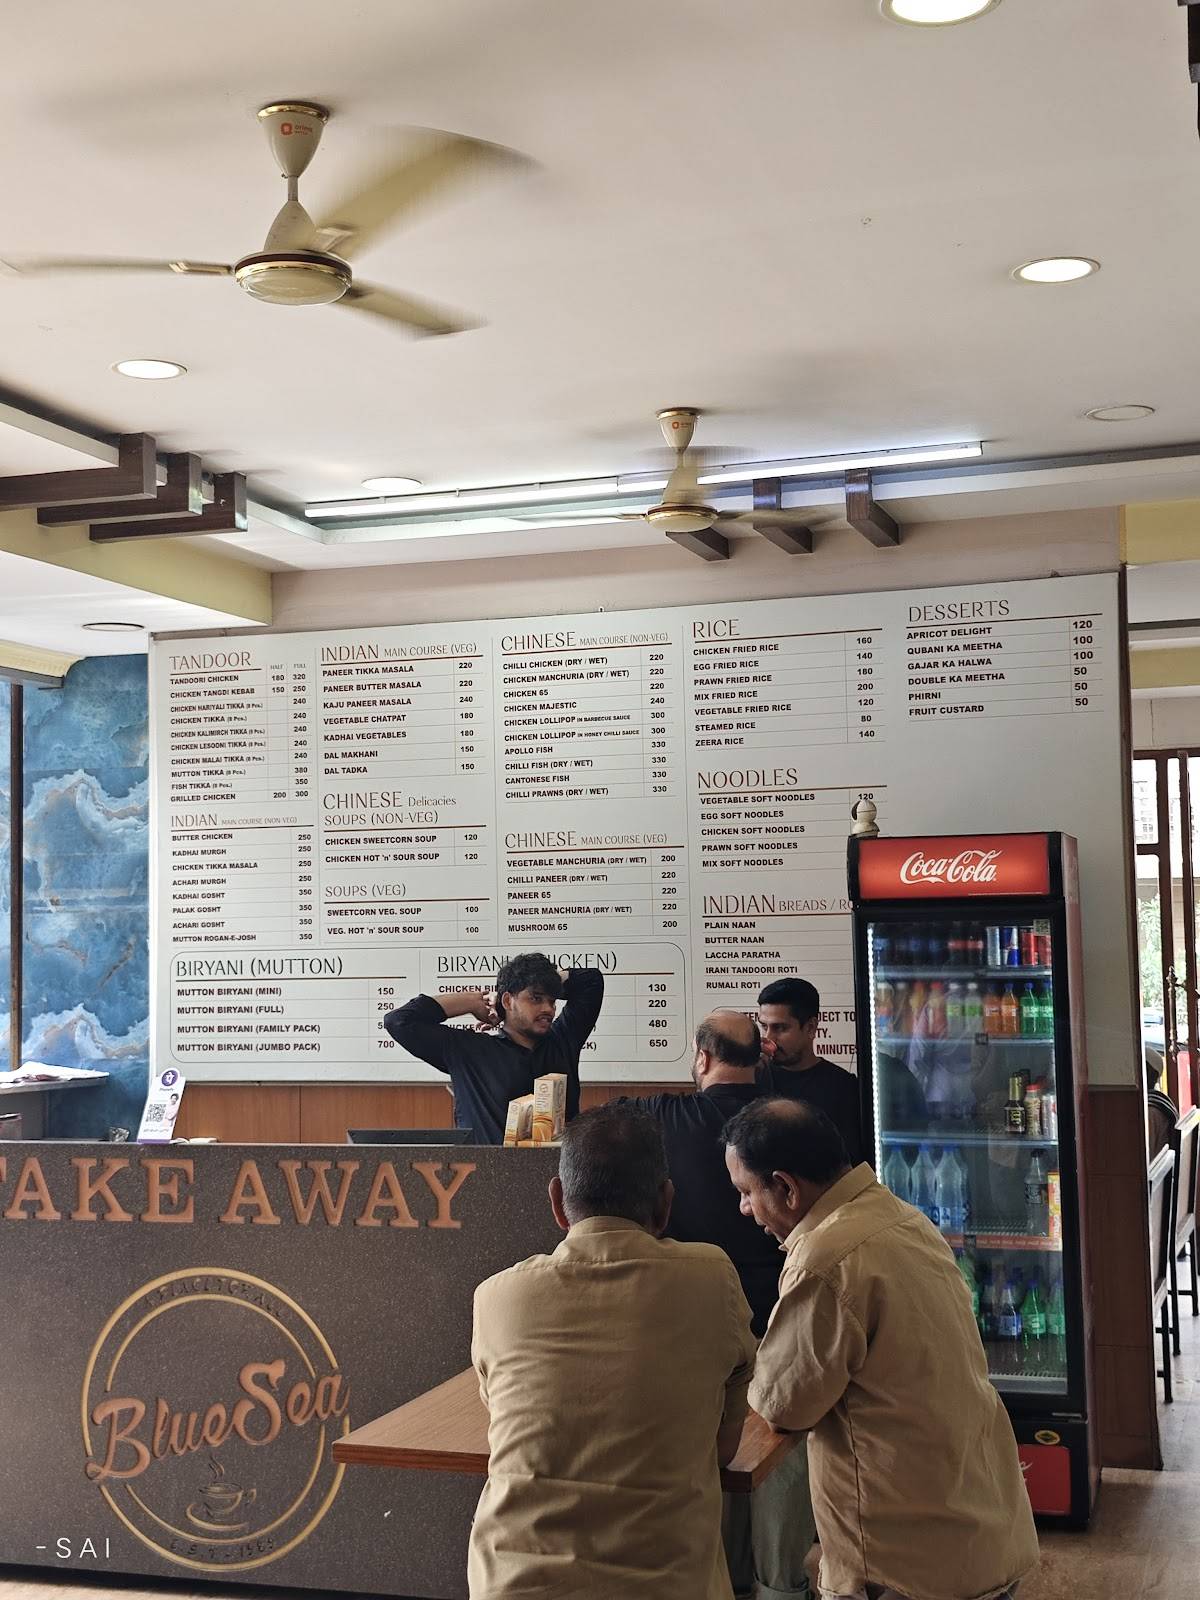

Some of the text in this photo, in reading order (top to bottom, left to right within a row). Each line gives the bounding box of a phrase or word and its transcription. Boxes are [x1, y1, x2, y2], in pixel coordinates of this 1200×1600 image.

[908, 599, 1010, 623] DESSERTS
[693, 619, 740, 639] RICE
[906, 620, 1093, 640] APRICOT DELIGHT 120
[501, 631, 576, 651] CHINESE
[579, 637, 598, 646] MAIN
[599, 635, 628, 645] COURSE
[907, 635, 1093, 656] QUBANI KA MEETHA 100
[321, 642, 477, 662] INDIAN MAIN COURSE (VEG)
[169, 651, 251, 671] TANDOOR
[693, 652, 873, 671] EGG FRIED RICE 140
[322, 668, 353, 677] PANEER
[355, 667, 380, 675] TIKKA
[381, 665, 414, 673] MASALA
[170, 673, 306, 685] TANDOORI CHICKEN 180 320
[170, 690, 201, 699] CHICKEN
[203, 689, 230, 697] TANGDI
[231, 687, 255, 695] KEBAB
[503, 682, 665, 698] CHICKEN 65 220
[908, 682, 1088, 701] PHIRNI 50
[504, 704, 538, 713] CHICKEN
[539, 701, 577, 710] MAJESTIC
[694, 698, 874, 716] VEGETABLE FRIED RICE 120
[909, 697, 1089, 716] FRUIT CUSTARD 50
[323, 716, 369, 725] VEGETABLE
[371, 714, 407, 723] CHATPAT
[695, 730, 875, 747] ZEERA RICE 140
[324, 752, 339, 760] DAL
[341, 750, 378, 759] MAKHANI
[504, 747, 534, 755] APOLLO
[535, 746, 553, 754] FISH
[342, 766, 368, 774] TADKA
[505, 776, 551, 785] CANTONESE
[697, 767, 798, 789] NOODLES
[170, 794, 201, 802] GRILLED
[203, 793, 236, 801] CHICKEN
[323, 791, 457, 810] CHINESE Delicacies
[700, 796, 749, 805] VEGETABLE
[751, 795, 773, 803] SOFT
[775, 793, 815, 802] NOODLES
[171, 814, 218, 828] INDIAN
[324, 810, 439, 826] SOUPS (NON-VEG)
[172, 834, 200, 842] BUTTER
[325, 837, 361, 845] CHICKEN
[363, 836, 413, 845] SWEETCORN
[414, 835, 437, 843] SOUP
[505, 830, 668, 849] CHINESE MAIN COURSE (VEG)
[701, 842, 798, 852] PRAWN SOFT NOODLES
[900, 849, 1003, 885] Coca-Cola
[325, 883, 407, 898] SOUPS (VEG)
[507, 887, 677, 900] PANEER 65 220
[703, 894, 776, 914] INDIAN
[779, 900, 827, 912] BREADS
[508, 924, 555, 932] MUSHROOM
[557, 923, 568, 931] 65
[731, 921, 756, 929] NAAN
[741, 951, 781, 959] PARATHA
[176, 956, 343, 977] BIRYANI (MUTTON)
[437, 955, 510, 973] BIRYAN
[177, 987, 395, 997] MUTTON BIRYANI (MINI) 150
[438, 985, 482, 993] CHICKEN
[648, 983, 667, 992] 130
[648, 999, 667, 1008] 220
[177, 1024, 321, 1034] MUTTON BIRYANI (FAMILY PACK)
[649, 1019, 667, 1028] 480
[177, 1040, 395, 1052] MUTTON BIRYANI (JUMBO PACK) 700
[649, 1039, 668, 1048] 650
[0, 1156, 477, 1229] AKE AWAY
